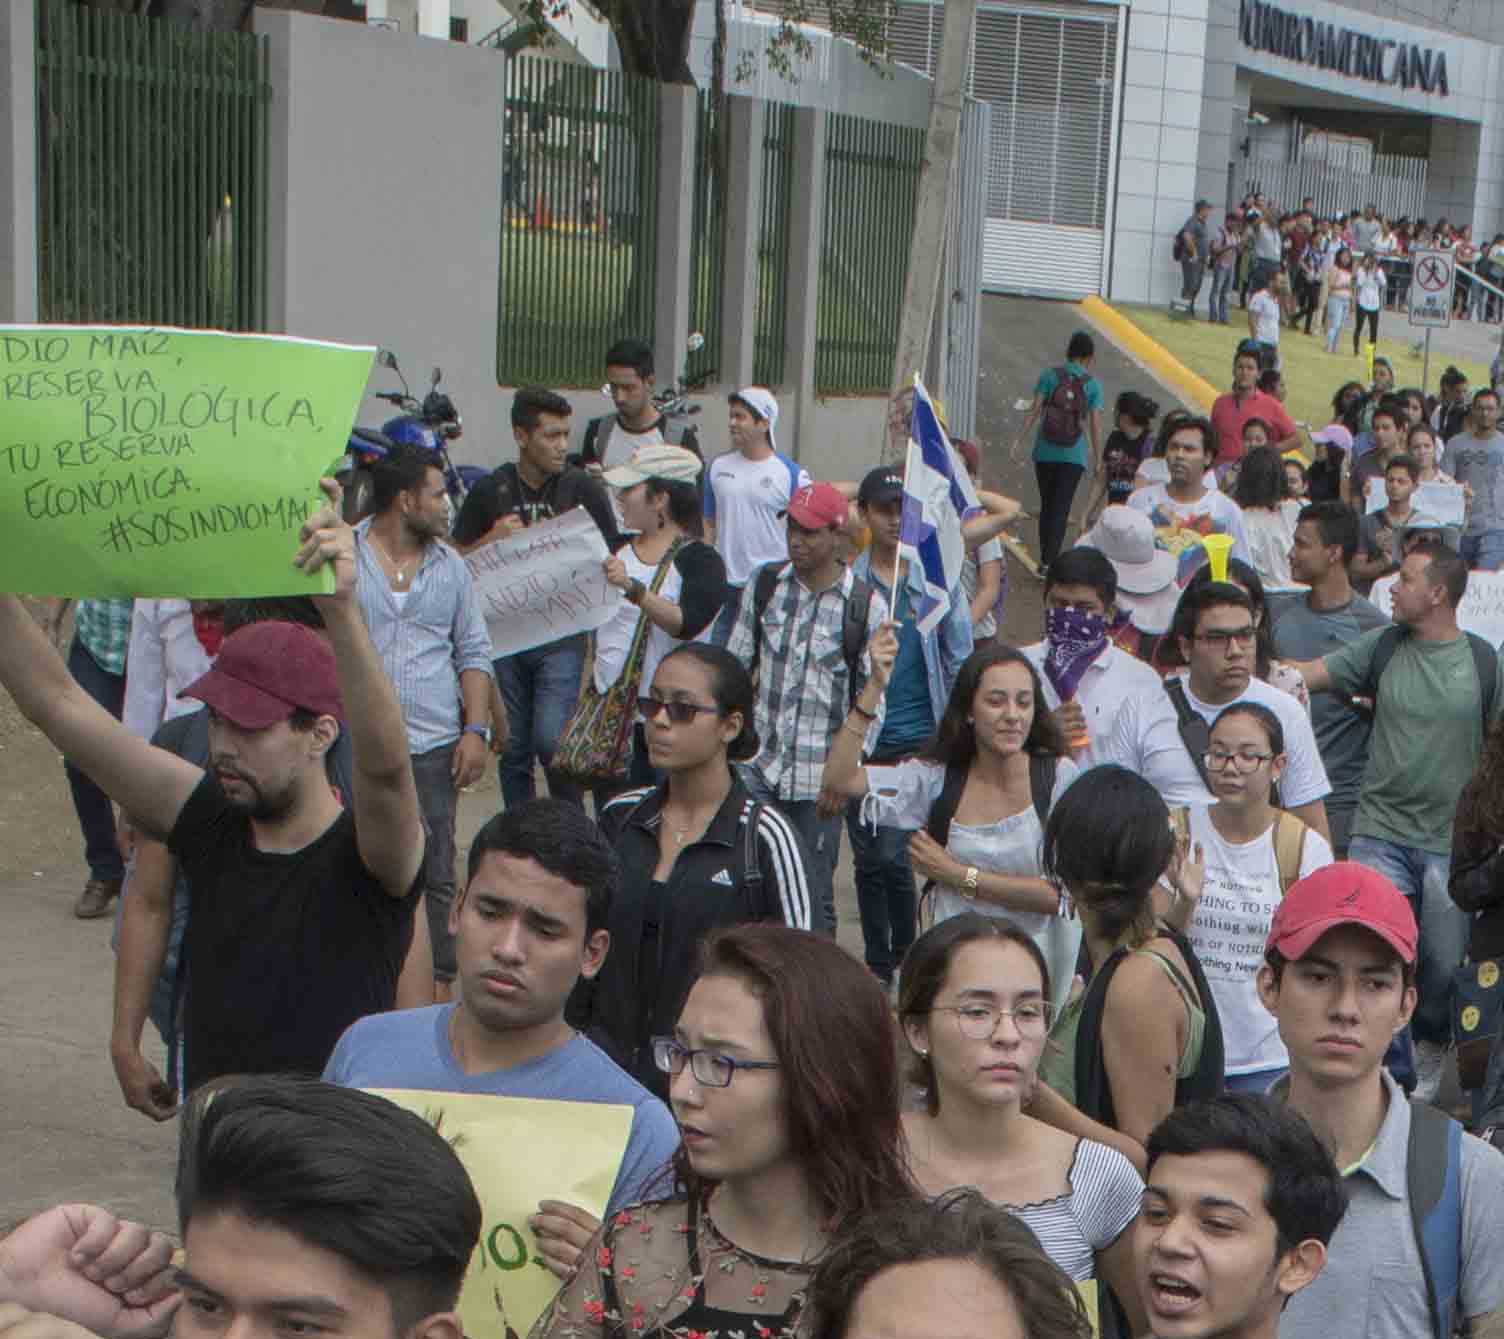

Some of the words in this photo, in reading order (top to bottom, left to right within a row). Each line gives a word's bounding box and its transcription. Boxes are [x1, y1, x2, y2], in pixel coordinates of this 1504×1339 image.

[3, 368, 158, 401] RESERVA
[0, 442, 41, 475] TU
[56, 432, 195, 470] RESERVA
[1198, 895, 1236, 912] HING
[1239, 901, 1260, 914] TO
[1227, 942, 1264, 955] NOTHI
